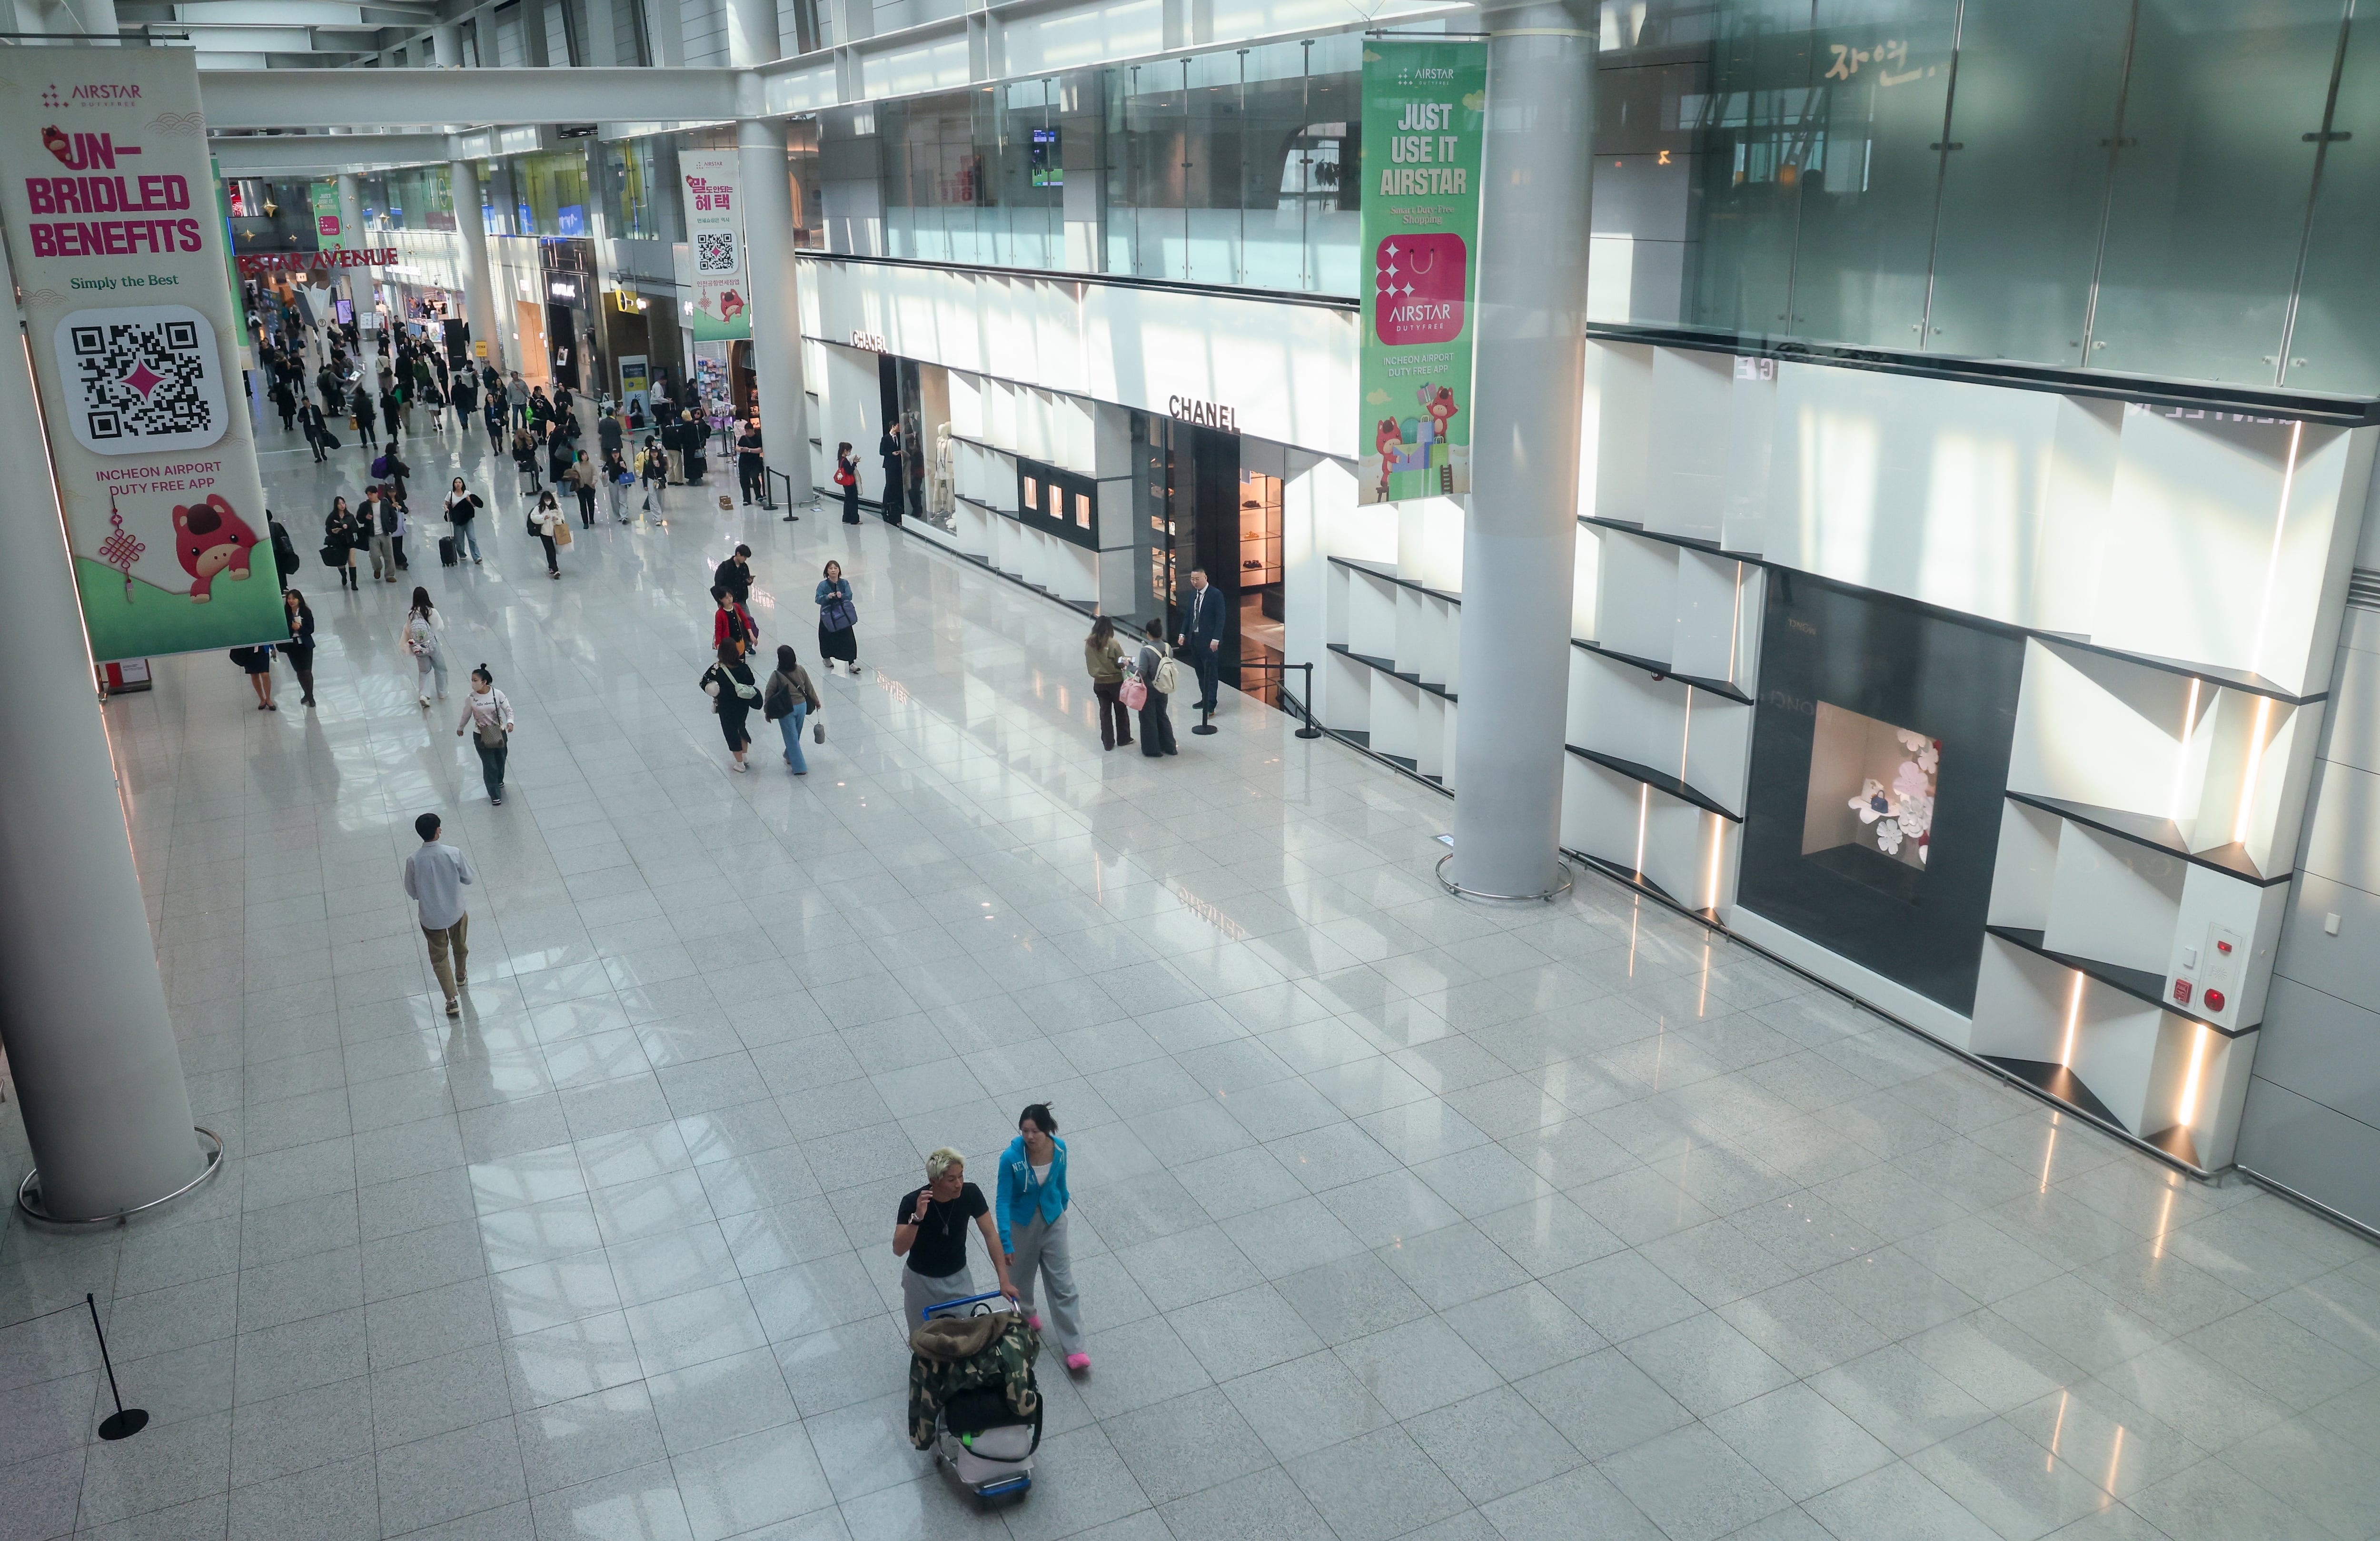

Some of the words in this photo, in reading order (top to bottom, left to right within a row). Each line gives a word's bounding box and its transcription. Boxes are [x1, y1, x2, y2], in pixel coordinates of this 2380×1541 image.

[1415, 69, 1454, 79] AIRSTAR
[72, 85, 142, 99] AIRSTAR
[1398, 103, 1452, 131] JUST
[1391, 136, 1432, 163] USE
[1438, 136, 1458, 162] IT
[1380, 168, 1466, 196] AIRSTAR
[25, 175, 190, 214] BRIDLED
[1390, 206, 1414, 214] Smart
[1416, 205, 1454, 215] Duty-Free
[1403, 215, 1442, 225] Shopping
[29, 218, 202, 257] BENEFITS
[238, 253, 305, 272] RSTAR
[311, 248, 398, 268] AVENUE
[70, 277, 116, 290] Simply
[121, 276, 145, 287] the
[148, 274, 178, 286] Best
[1389, 304, 1450, 322] AIRSTAR
[1397, 323, 1444, 332] DUTYFREE
[853, 330, 888, 354] CHANEL
[1383, 354, 1419, 366] INCHEON
[1421, 353, 1454, 363] AIRPORT
[1388, 367, 1411, 377] DUTY
[1413, 365, 1431, 375] FREE
[1432, 365, 1448, 374] APP
[1169, 395, 1241, 433] CHANEL
[96, 466, 160, 481] INCHEON
[164, 461, 221, 476] AIRPORT
[109, 482, 148, 496] DUTY
[152, 480, 185, 492] FREE
[189, 477, 215, 490] APP
